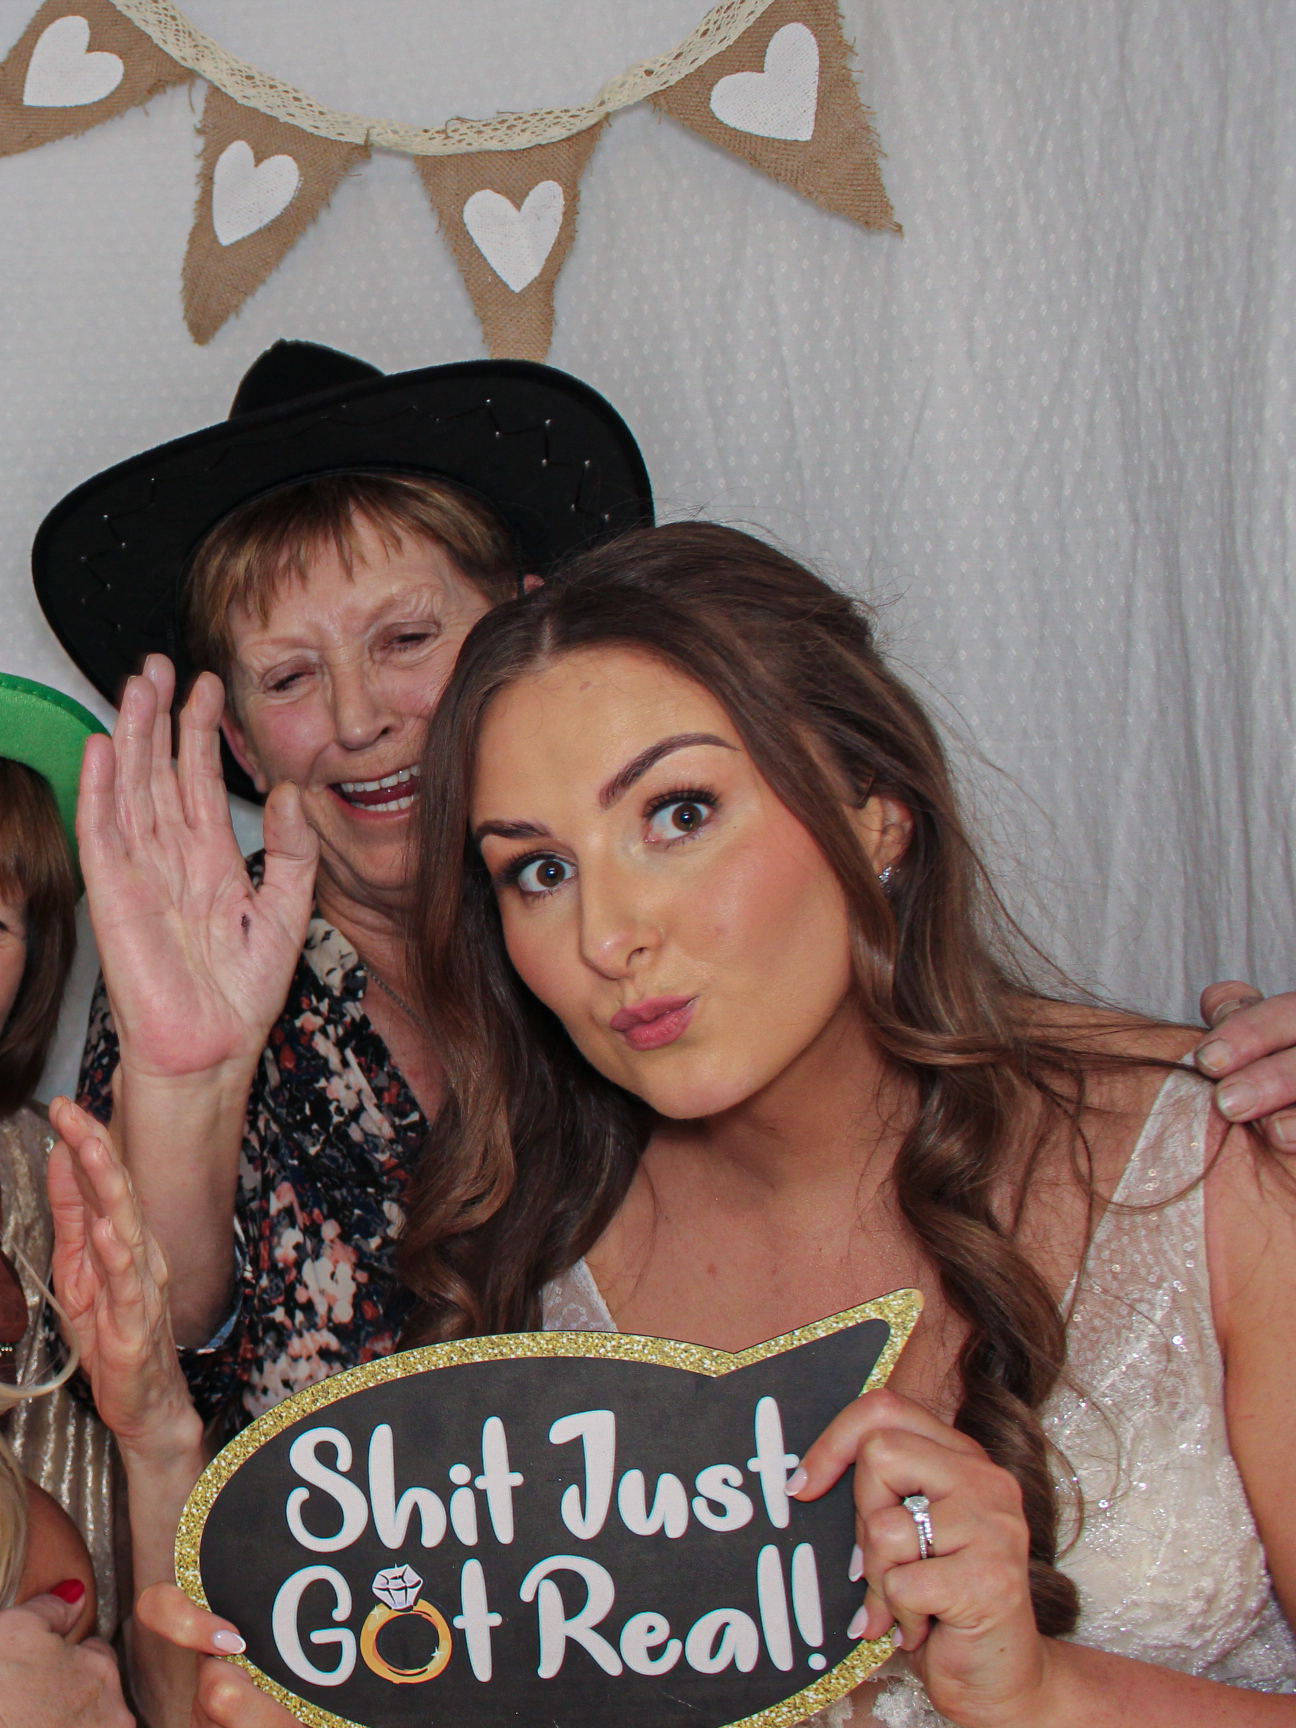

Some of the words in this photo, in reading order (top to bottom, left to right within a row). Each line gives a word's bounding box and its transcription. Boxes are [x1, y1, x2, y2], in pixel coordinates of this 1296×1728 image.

[285, 1416, 523, 1552] Shit
[548, 1396, 800, 1541] Just
[271, 1558, 503, 1687] Got
[519, 1542, 828, 1679] Real!
